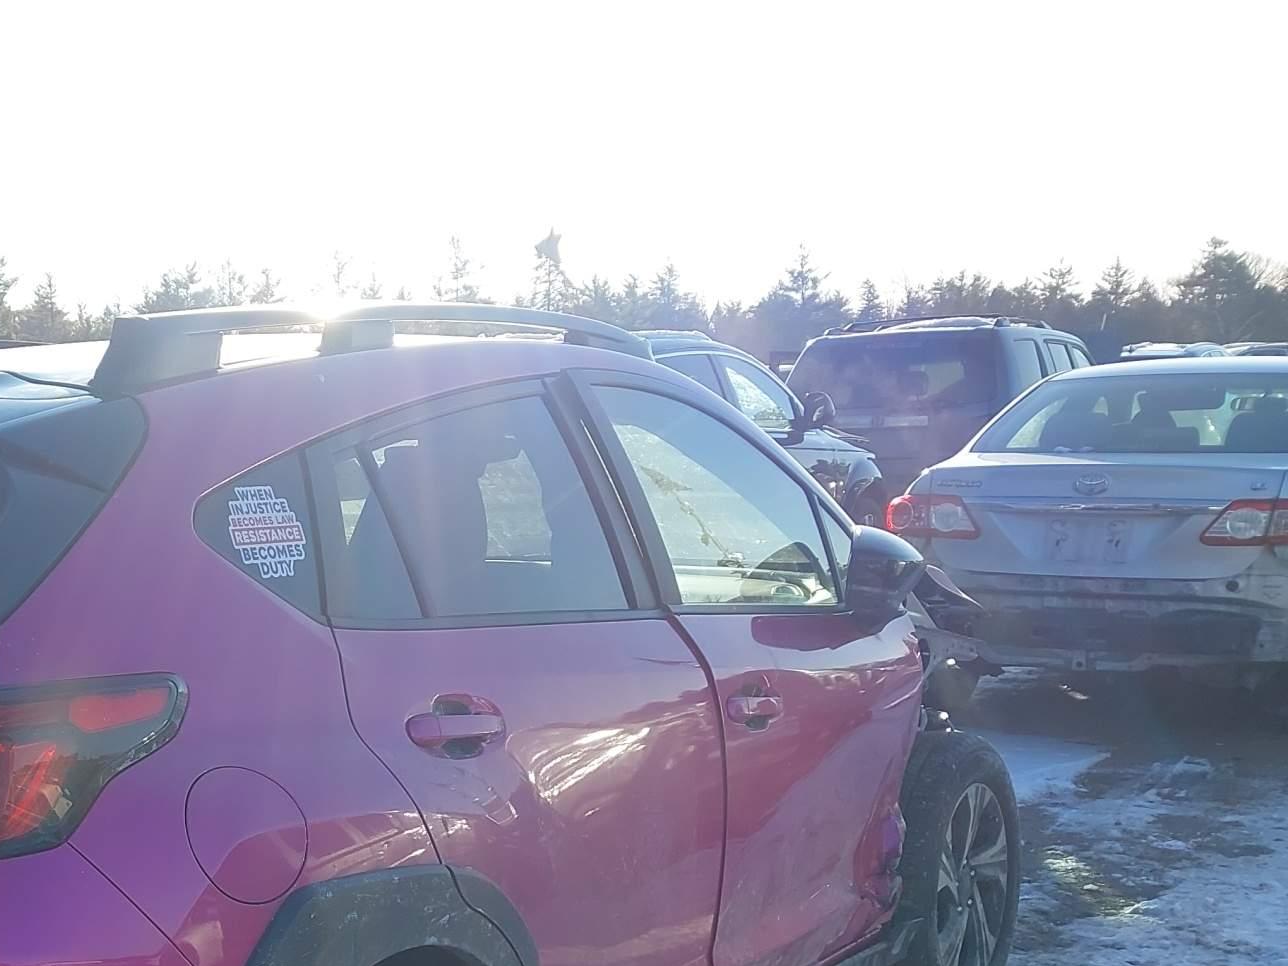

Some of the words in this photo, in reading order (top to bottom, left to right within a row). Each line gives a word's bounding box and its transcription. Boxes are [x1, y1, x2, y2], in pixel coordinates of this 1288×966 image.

[236, 488, 273, 501] WHEN
[231, 501, 289, 515] INJUSTICE
[231, 516, 274, 528] BECOMES
[275, 514, 296, 524] LAW
[234, 527, 301, 543] RESISTANCE
[241, 544, 303, 562] BECOMES
[259, 560, 293, 576] DUTY
